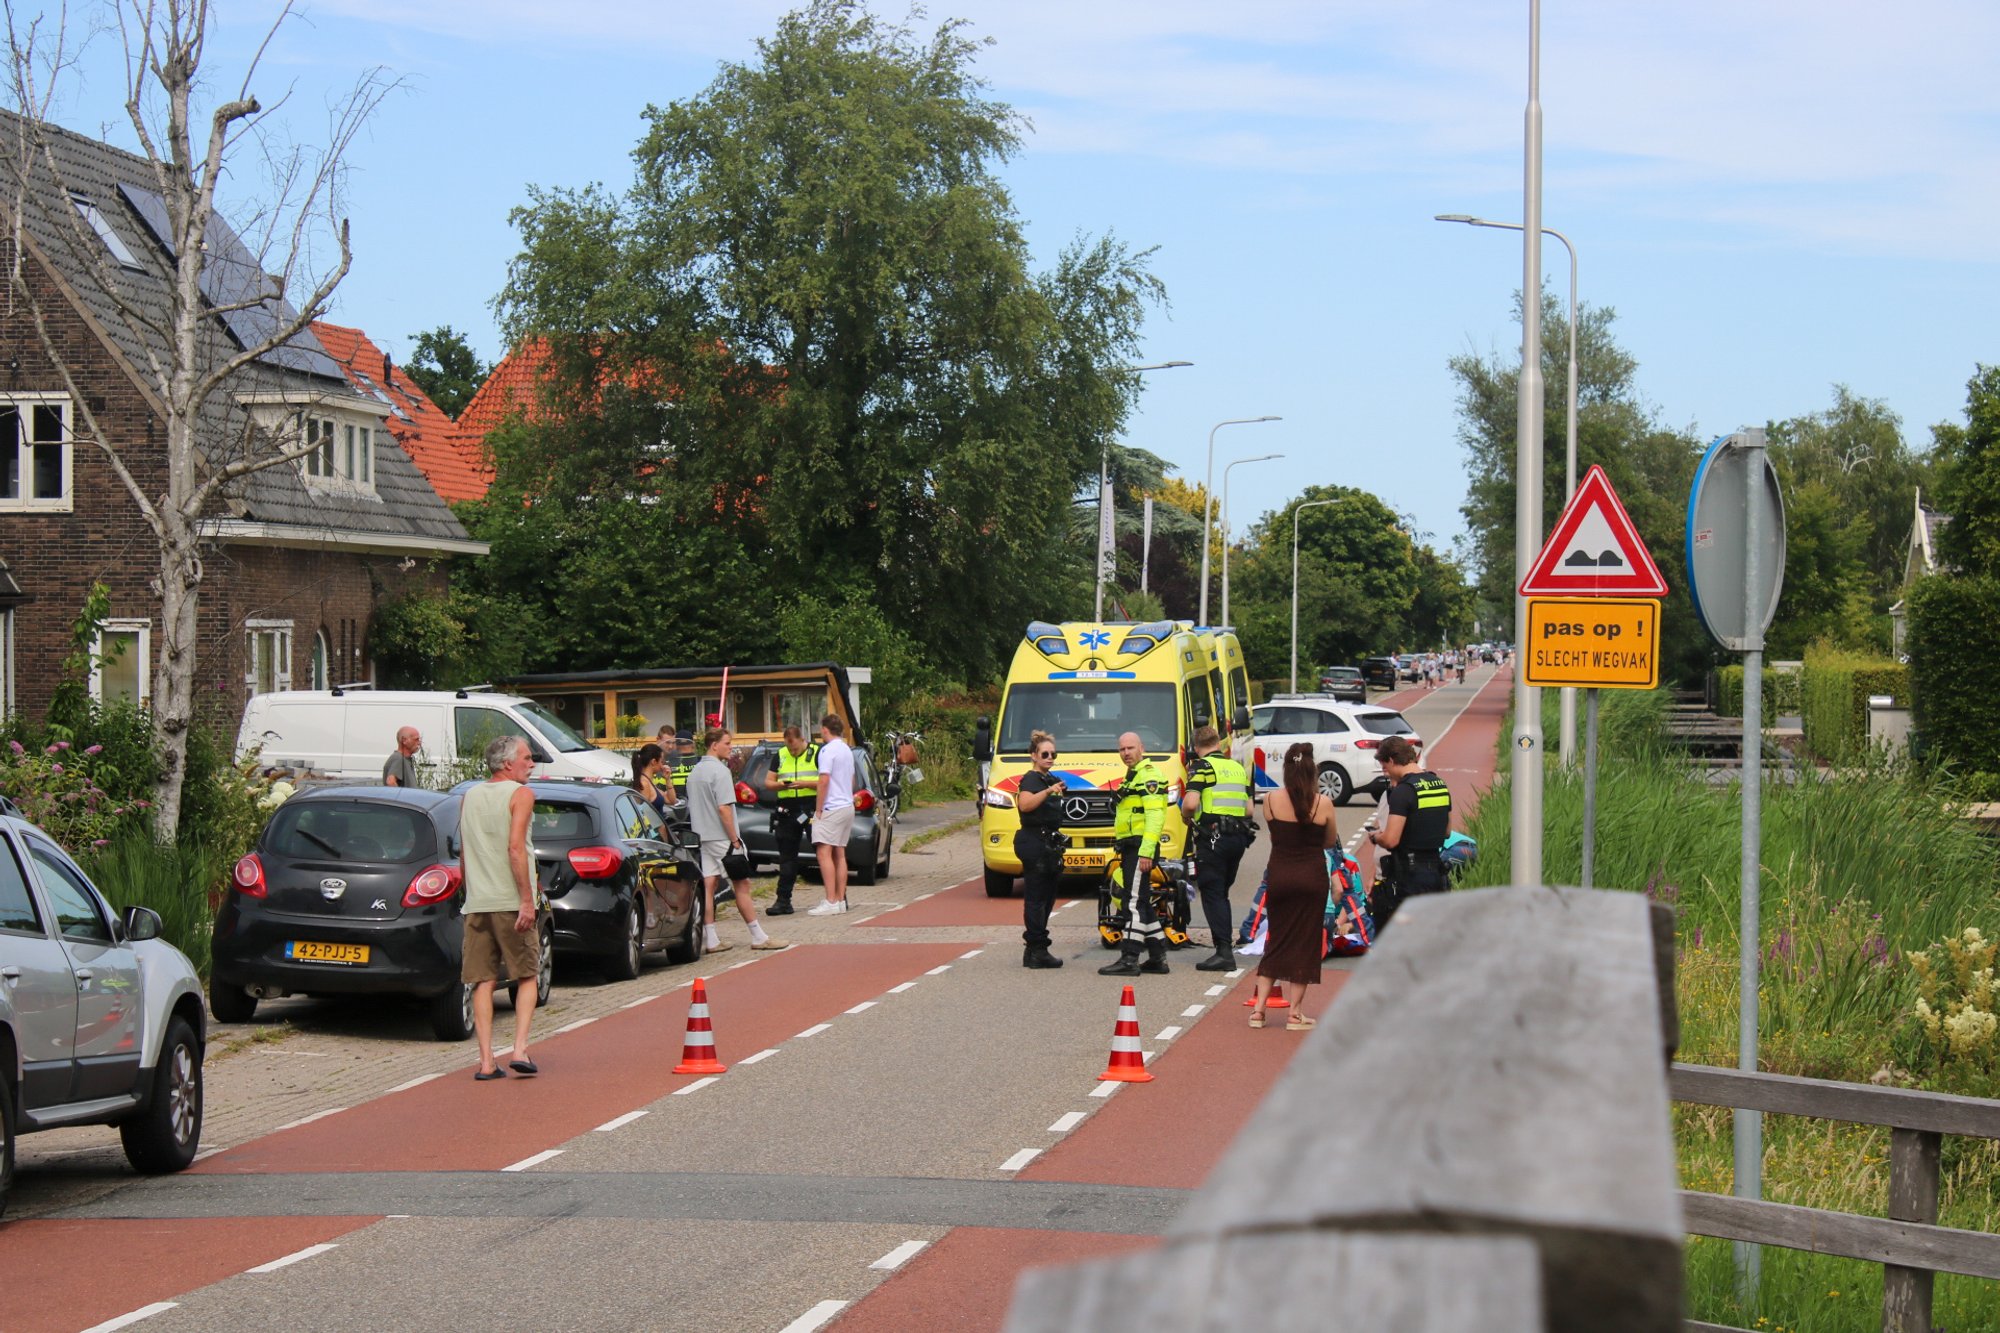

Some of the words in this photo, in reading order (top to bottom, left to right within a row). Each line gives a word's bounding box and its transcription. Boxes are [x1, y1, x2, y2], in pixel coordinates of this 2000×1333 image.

[1543, 621, 1585, 639] pas
[1592, 622, 1622, 640] op
[1636, 620, 1644, 637] !
[1536, 650, 1589, 667] SLECHT
[1592, 651, 1647, 669] WEGVAK
[299, 943, 362, 960] 42-PJJ-5
